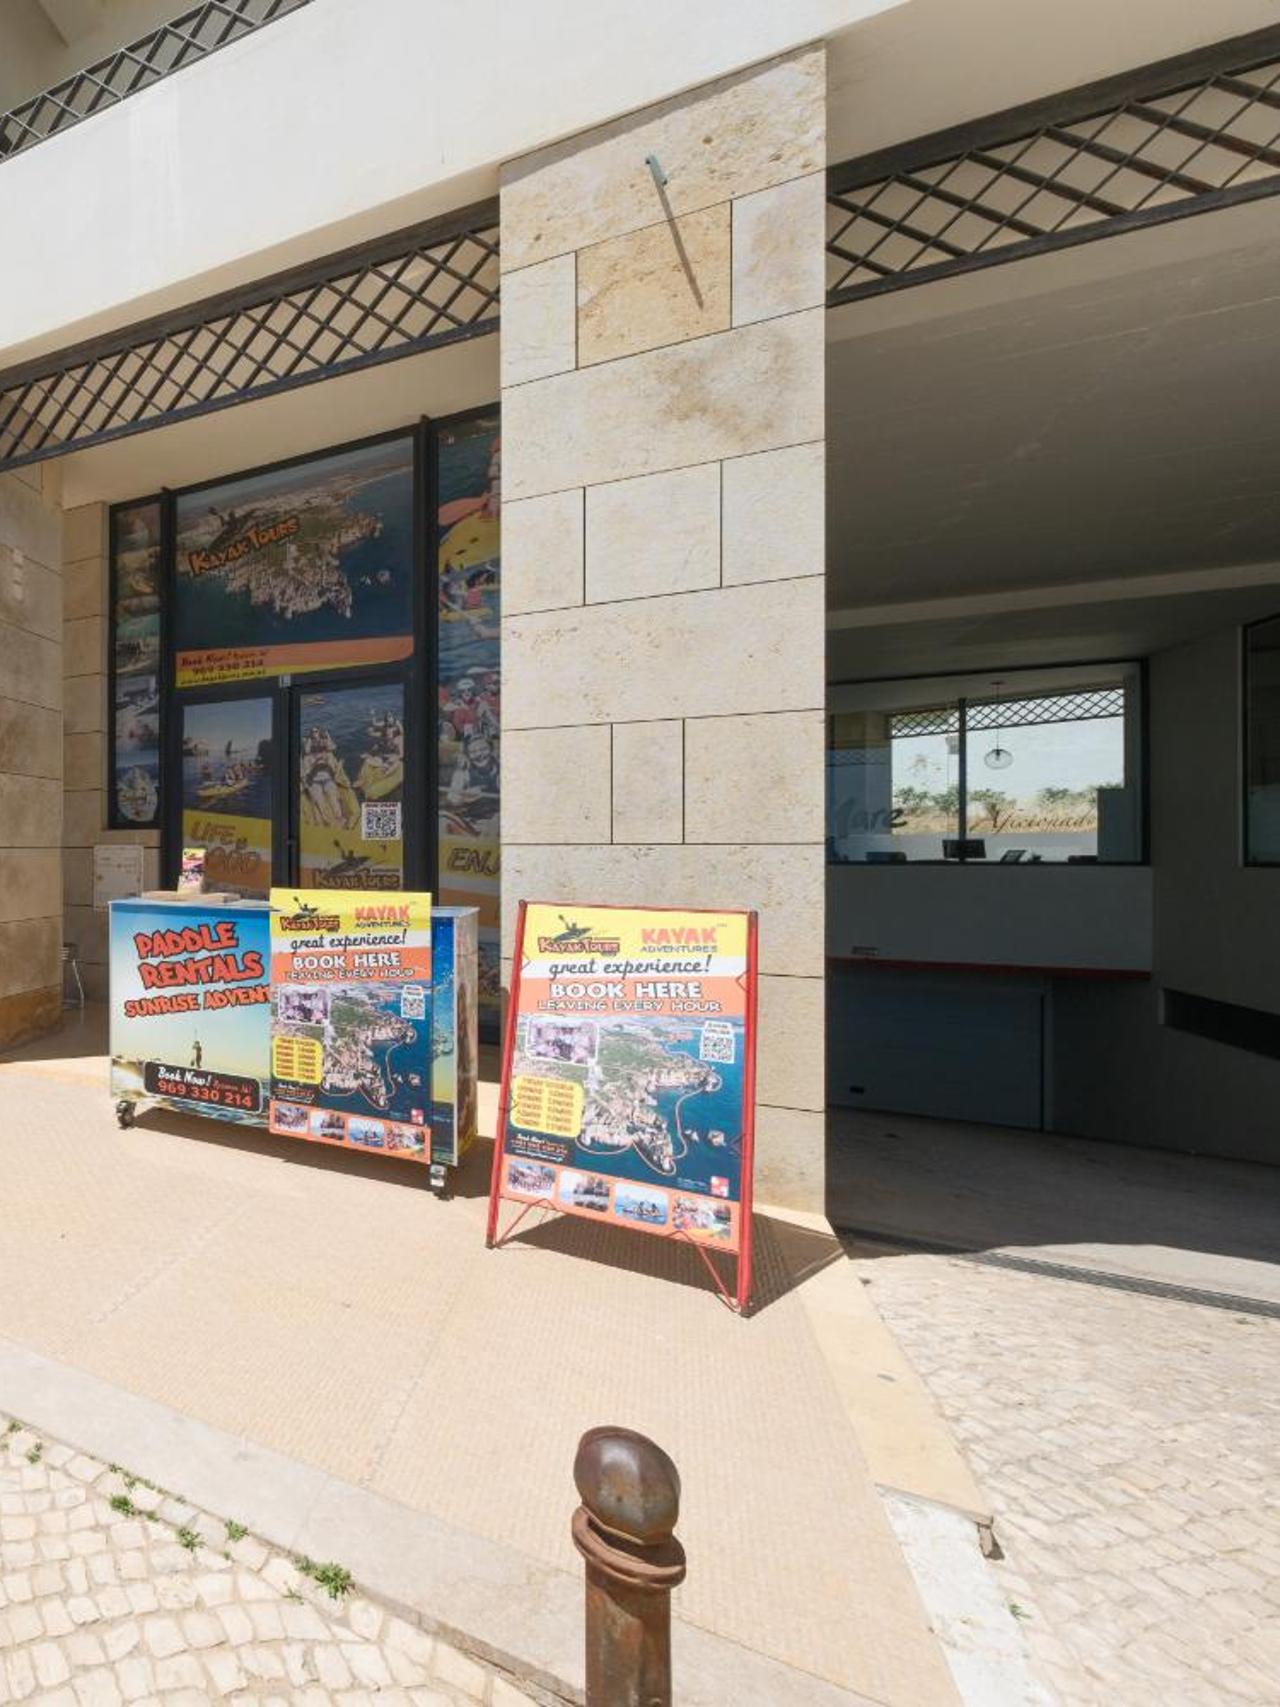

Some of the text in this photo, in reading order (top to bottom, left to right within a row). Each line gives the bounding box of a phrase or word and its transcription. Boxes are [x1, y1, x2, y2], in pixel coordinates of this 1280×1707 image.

[355, 904, 410, 920] KAYAK
[133, 921, 239, 959] PADDLE
[290, 928, 407, 954] great experience!
[641, 927, 717, 945] KAYAK
[640, 945, 718, 953] ADVENTURES
[138, 950, 265, 990] RENTALS
[293, 952, 401, 969] BOOK HERE
[548, 954, 713, 981] great experience!
[339, 969, 376, 979] EVERY
[550, 982, 703, 999] BOOK HERE
[125, 993, 200, 1018] SUNRISE
[538, 999, 723, 1013] LEAVING EVERY HOUR
[158, 1066, 212, 1086] Book Now!
[158, 1080, 187, 1095] 969
[190, 1086, 220, 1101] 330
[224, 1092, 252, 1108] 214
